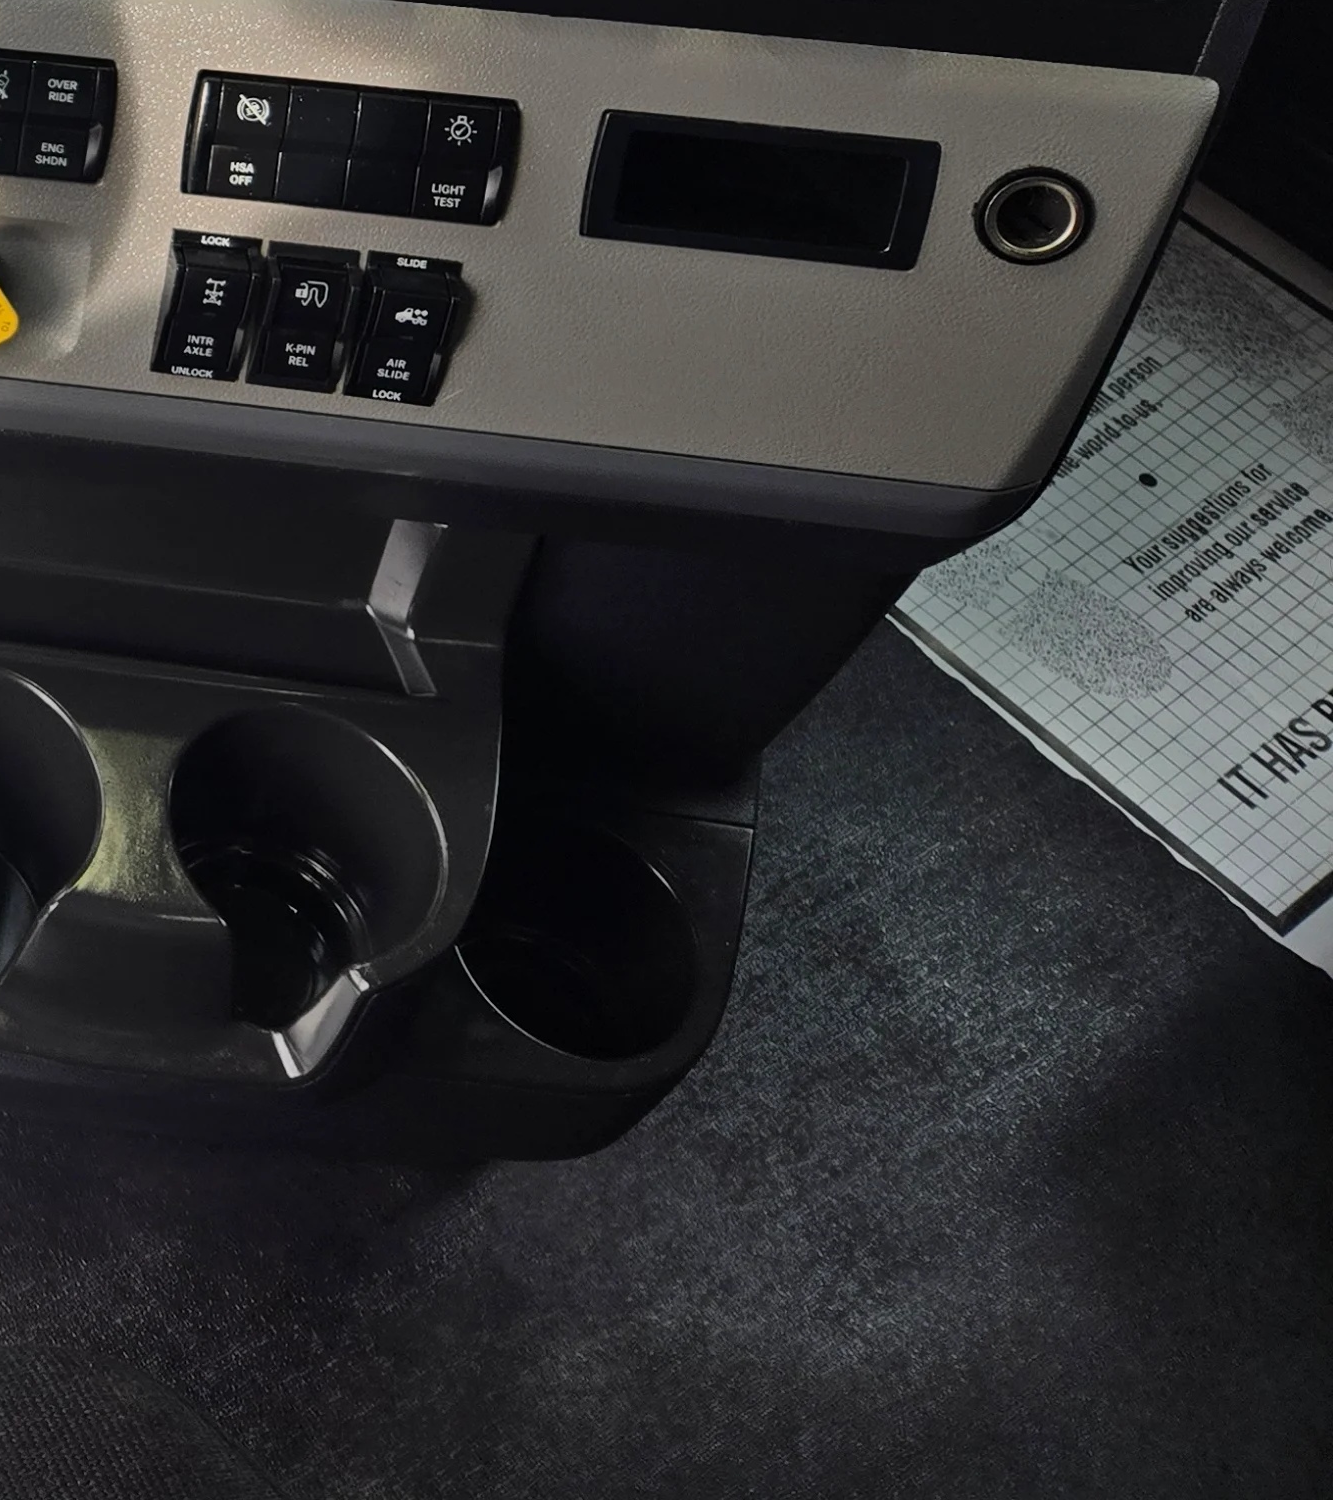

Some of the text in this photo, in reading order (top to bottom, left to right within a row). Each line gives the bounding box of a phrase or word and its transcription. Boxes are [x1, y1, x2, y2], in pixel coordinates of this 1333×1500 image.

[47, 78, 78, 91] OVER
[48, 91, 75, 104] RIDE
[41, 142, 65, 154] ENG
[35, 154, 68, 167] SHDN
[230, 161, 255, 174] HSA
[229, 174, 253, 186] OFF
[431, 183, 466, 196] LIGHT
[433, 196, 461, 208] TEST
[200, 235, 230, 248] LOCK
[396, 257, 428, 270] SLIDE
[1, 320, 11, 332] TO
[187, 334, 215, 347] INTR
[183, 345, 213, 358] AXLE
[285, 342, 317, 356] K-PIN
[287, 355, 309, 368] REL
[386, 358, 407, 369] AIR
[171, 365, 214, 379] UNLOCK
[376, 368, 411, 381] SLIDE
[1108, 357, 1162, 399] person
[371, 389, 402, 402] LOCK
[1074, 413, 1138, 460] world to
[1123, 463, 1273, 575] Your suggestions for
[1148, 482, 1310, 601] improving our service
[1185, 597, 1217, 623] are
[1210, 558, 1267, 604] always
[1217, 717, 1333, 809] IT HAS
